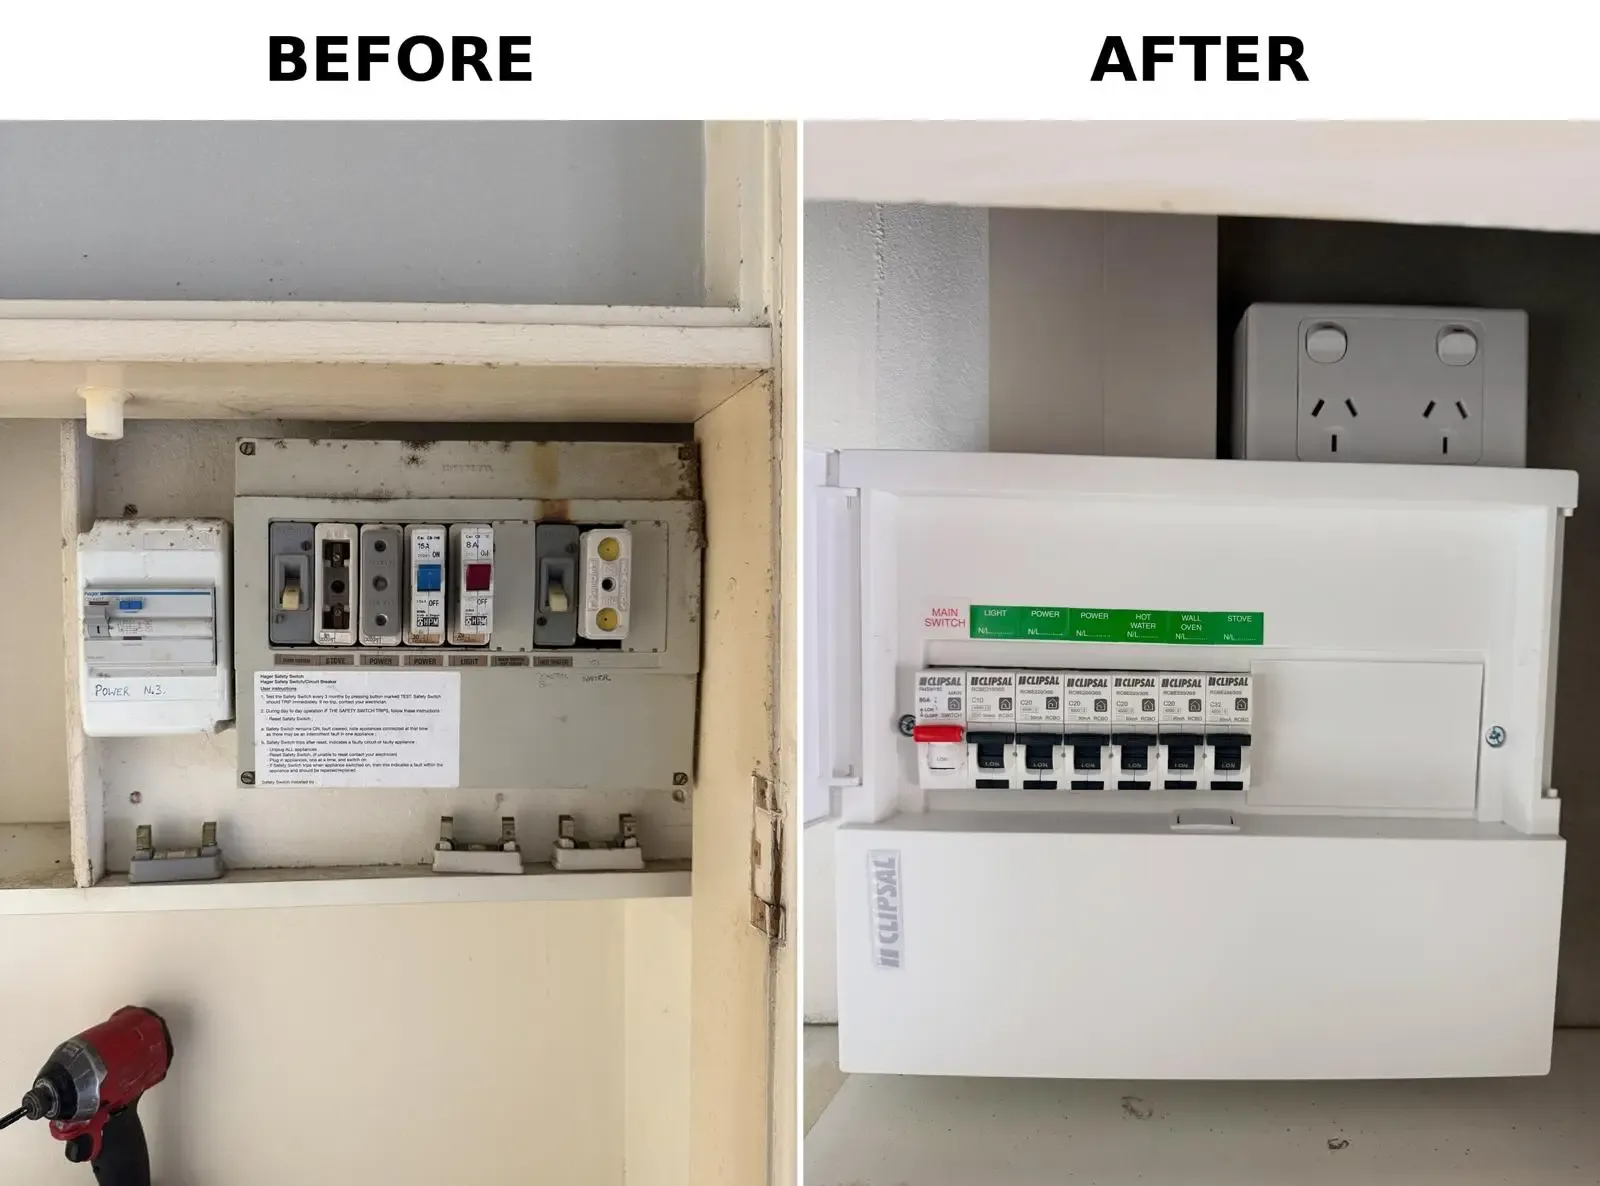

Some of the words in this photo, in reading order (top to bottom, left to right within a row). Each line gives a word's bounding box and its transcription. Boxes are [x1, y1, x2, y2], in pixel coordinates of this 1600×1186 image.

[932, 608, 958, 616] MAIN
[1031, 610, 1060, 618] POWER
[1080, 612, 1110, 620] POWER
[925, 619, 965, 627] SWITCH
[928, 677, 961, 686] CLIPSAL
[978, 677, 1012, 685] CLIPSAL
[1026, 676, 1059, 685] CLIPSAL
[1075, 679, 1107, 687] CLIPSAL
[1122, 679, 1155, 687] CLIPSAL
[1169, 679, 1202, 687] CLIPSAL
[1216, 678, 1248, 686] CLIPSAL
[95, 684, 130, 696] POWER
[873, 856, 898, 944] CLIPSAL
